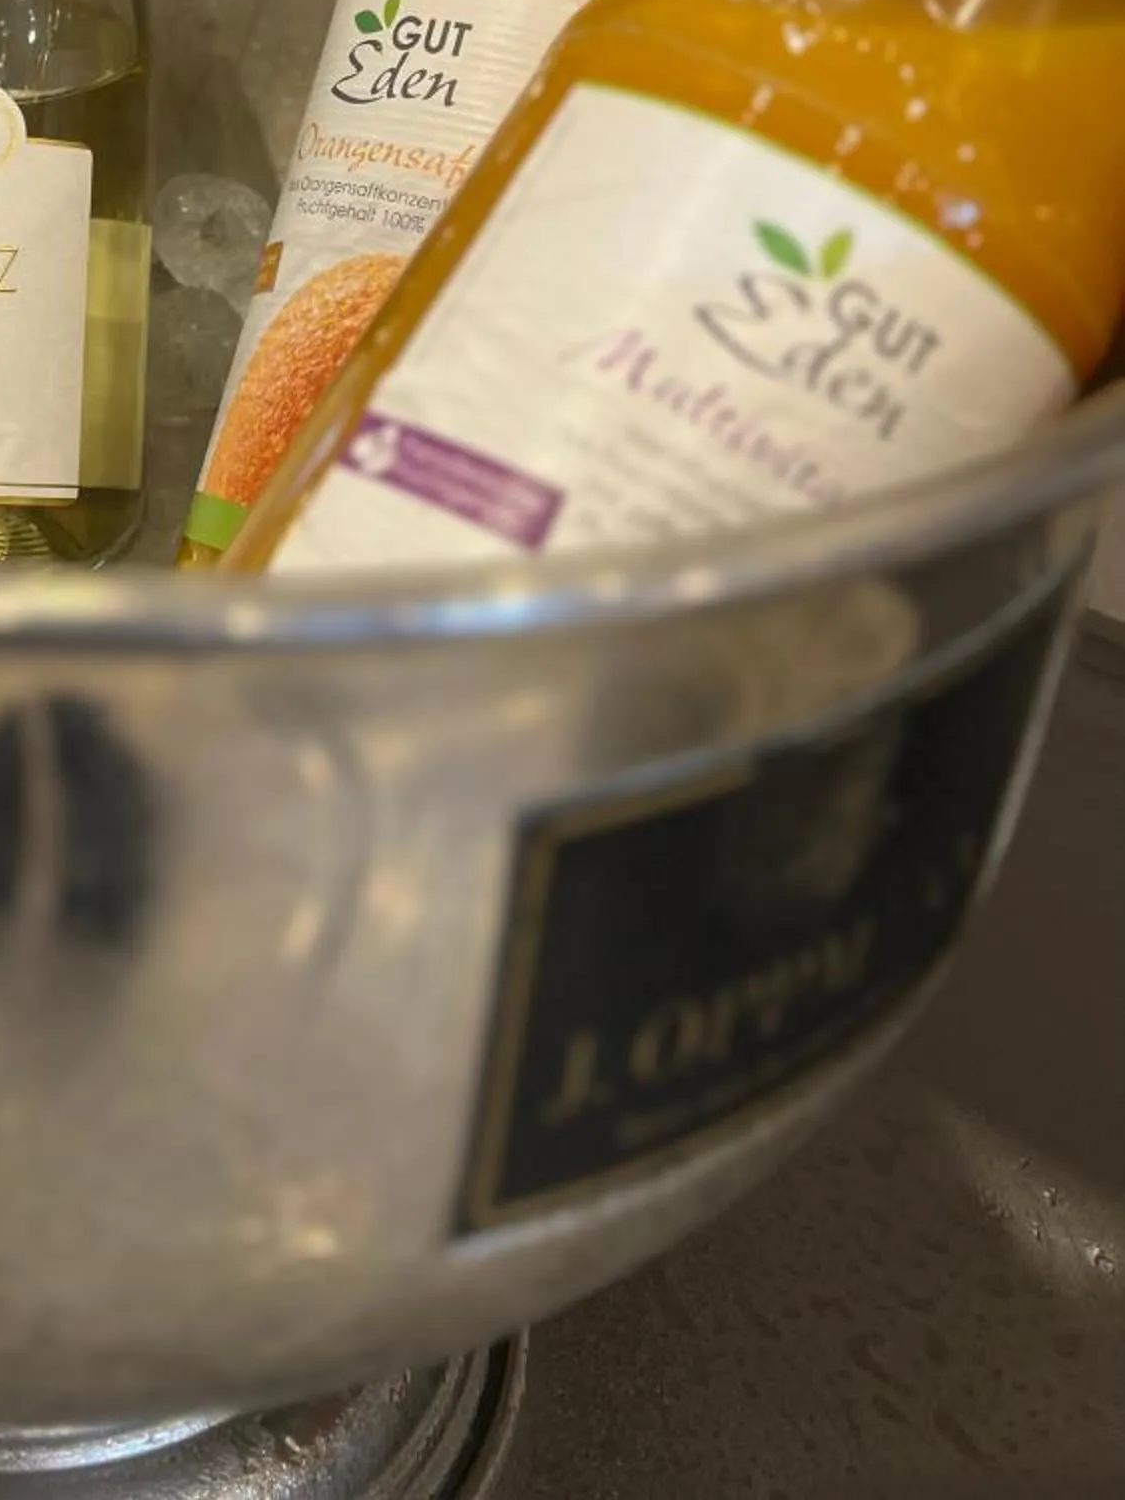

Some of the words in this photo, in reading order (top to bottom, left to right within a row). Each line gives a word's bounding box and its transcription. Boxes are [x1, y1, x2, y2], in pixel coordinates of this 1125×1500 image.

[390, 13, 474, 58] GUT
[330, 39, 460, 108] Eden
[297, 122, 477, 189] Orangensaf
[693, 272, 906, 442] Eden
[828, 279, 941, 375] GUT
